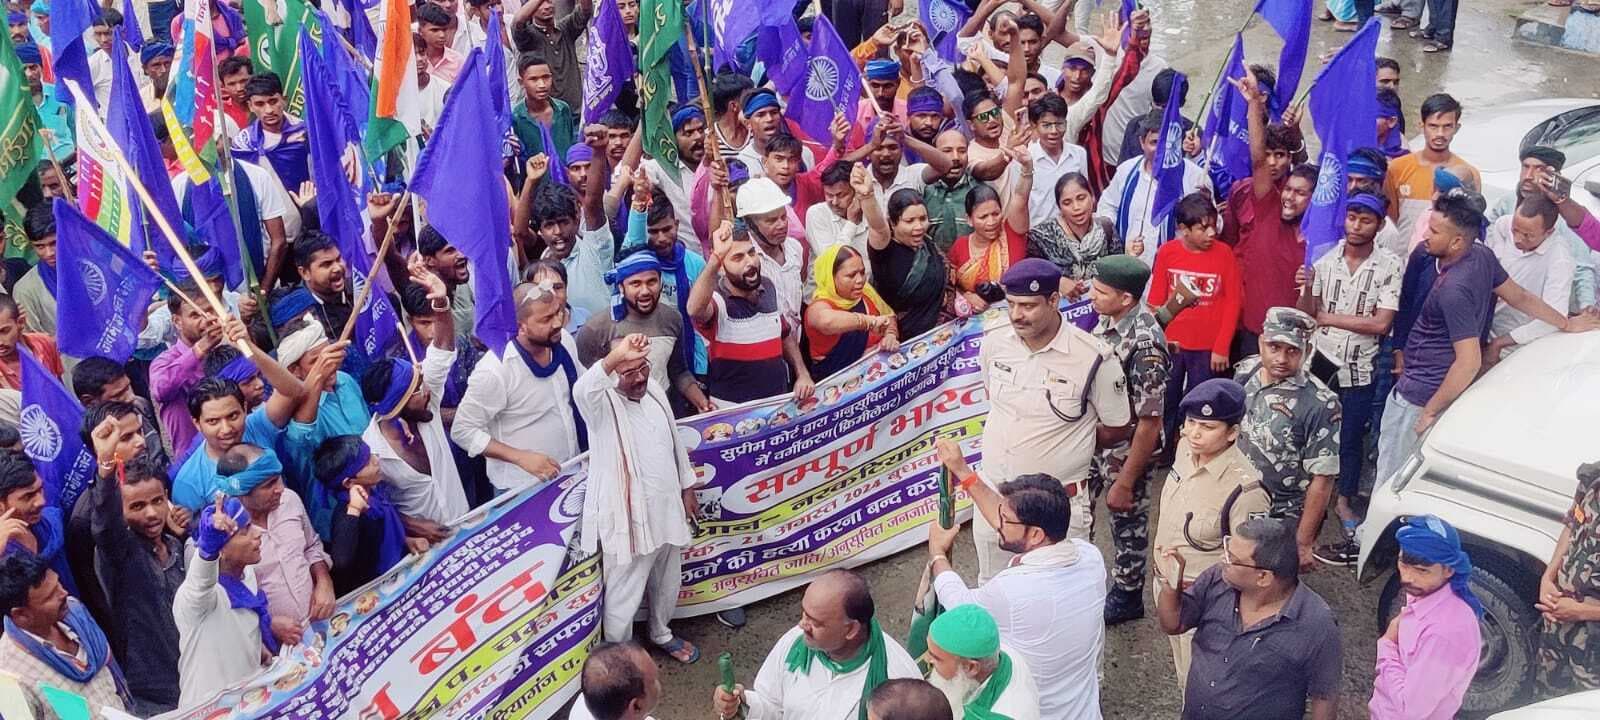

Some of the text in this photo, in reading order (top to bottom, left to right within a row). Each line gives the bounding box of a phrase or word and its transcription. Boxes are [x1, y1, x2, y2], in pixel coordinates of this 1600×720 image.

[720, 440, 766, 462] सुप्रीम
[769, 425, 800, 445] कोर्ट
[802, 414, 828, 433] द्वारा
[831, 387, 887, 421] अनुसूचित
[755, 452, 771, 467] में
[744, 420, 882, 504] सम्पूर्ण
[726, 551, 756, 571] की
[761, 534, 810, 560] हत्या
[813, 508, 863, 542] करना
[865, 489, 902, 516] बन्द
[742, 534, 764, 546] 21
[774, 500, 837, 539] अगस्त
[843, 480, 881, 503] 2024
[446, 559, 501, 600] समर्थन
[711, 564, 781, 594] अनुसूचित
[407, 560, 547, 676] बंद
